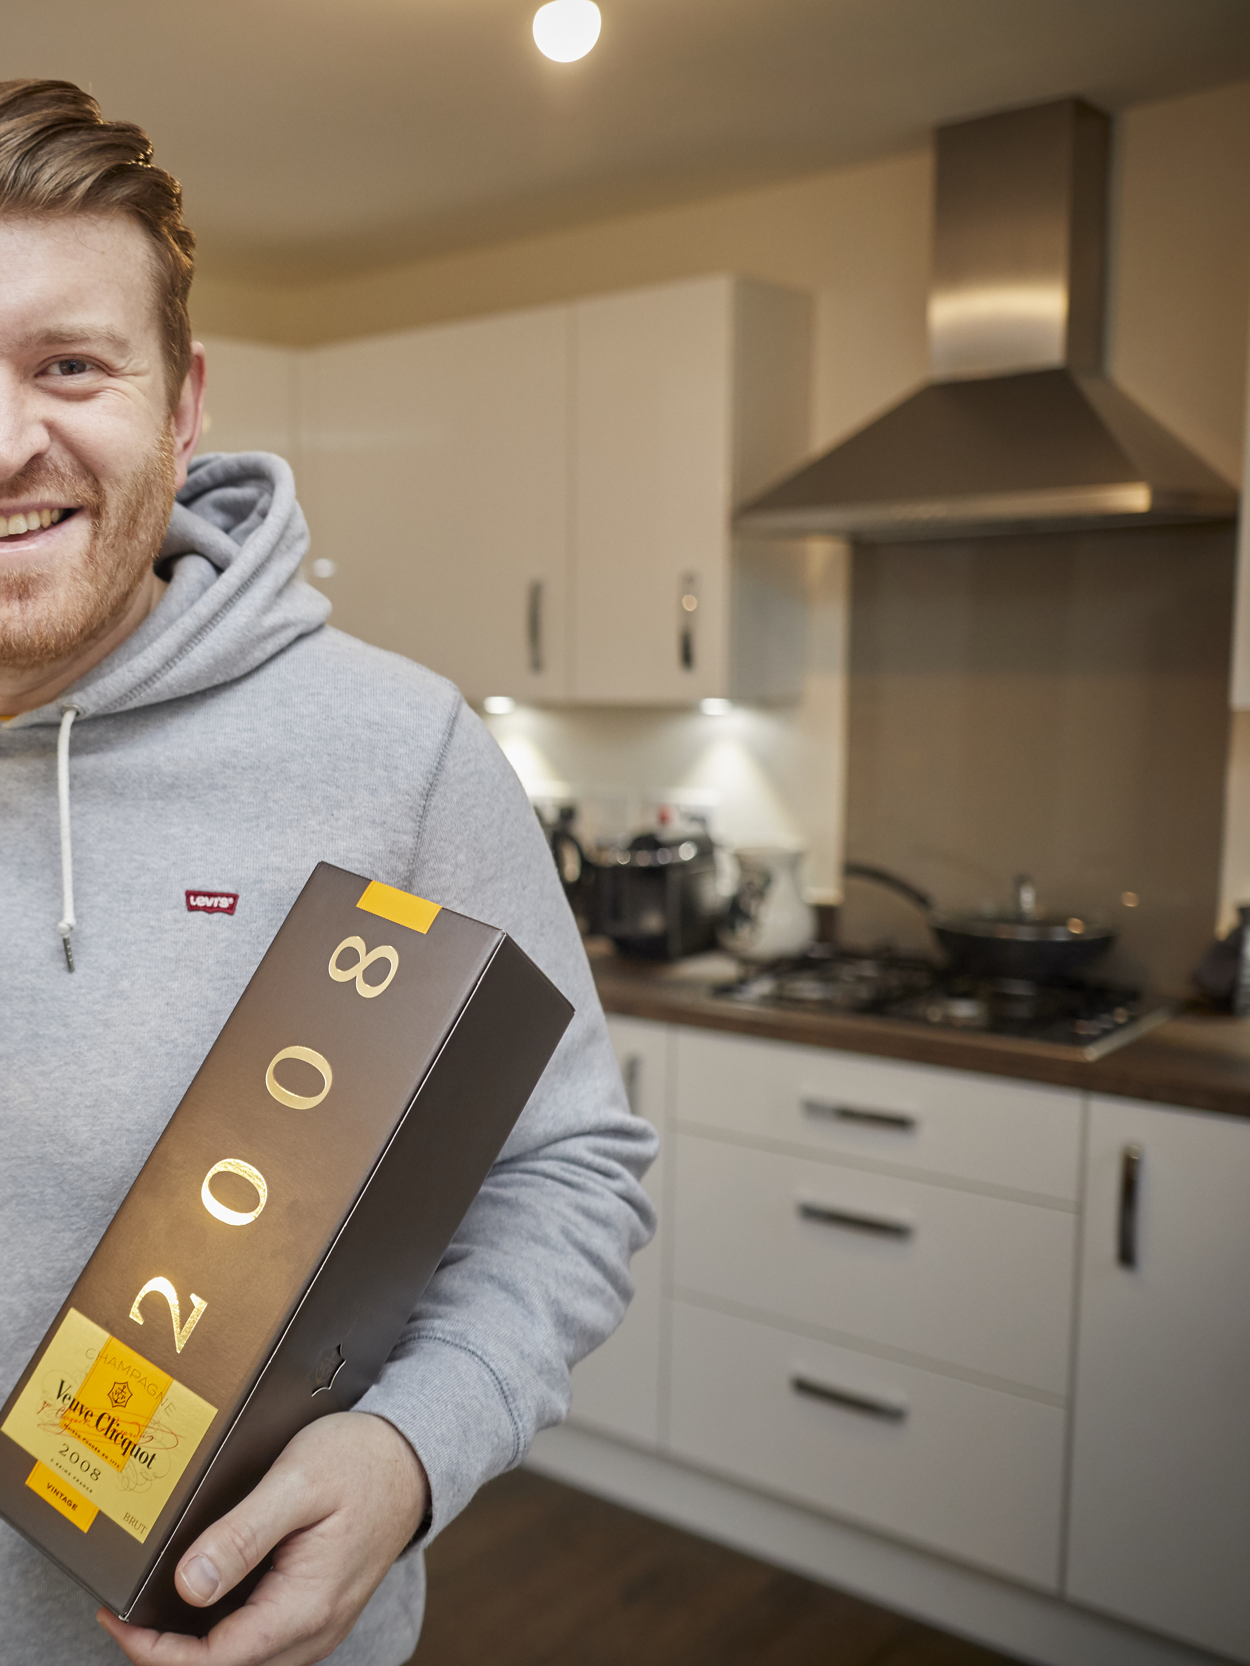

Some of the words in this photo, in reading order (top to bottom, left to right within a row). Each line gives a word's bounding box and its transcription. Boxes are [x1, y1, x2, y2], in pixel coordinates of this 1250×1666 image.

[85, 1348, 177, 1418] CHAMPAGNE
[55, 1378, 93, 1419] Veuve
[95, 1411, 157, 1469] Clicquot
[58, 1443, 102, 1481] 2008
[46, 1482, 78, 1511] VINTAGE
[122, 1512, 149, 1535] BRUT
